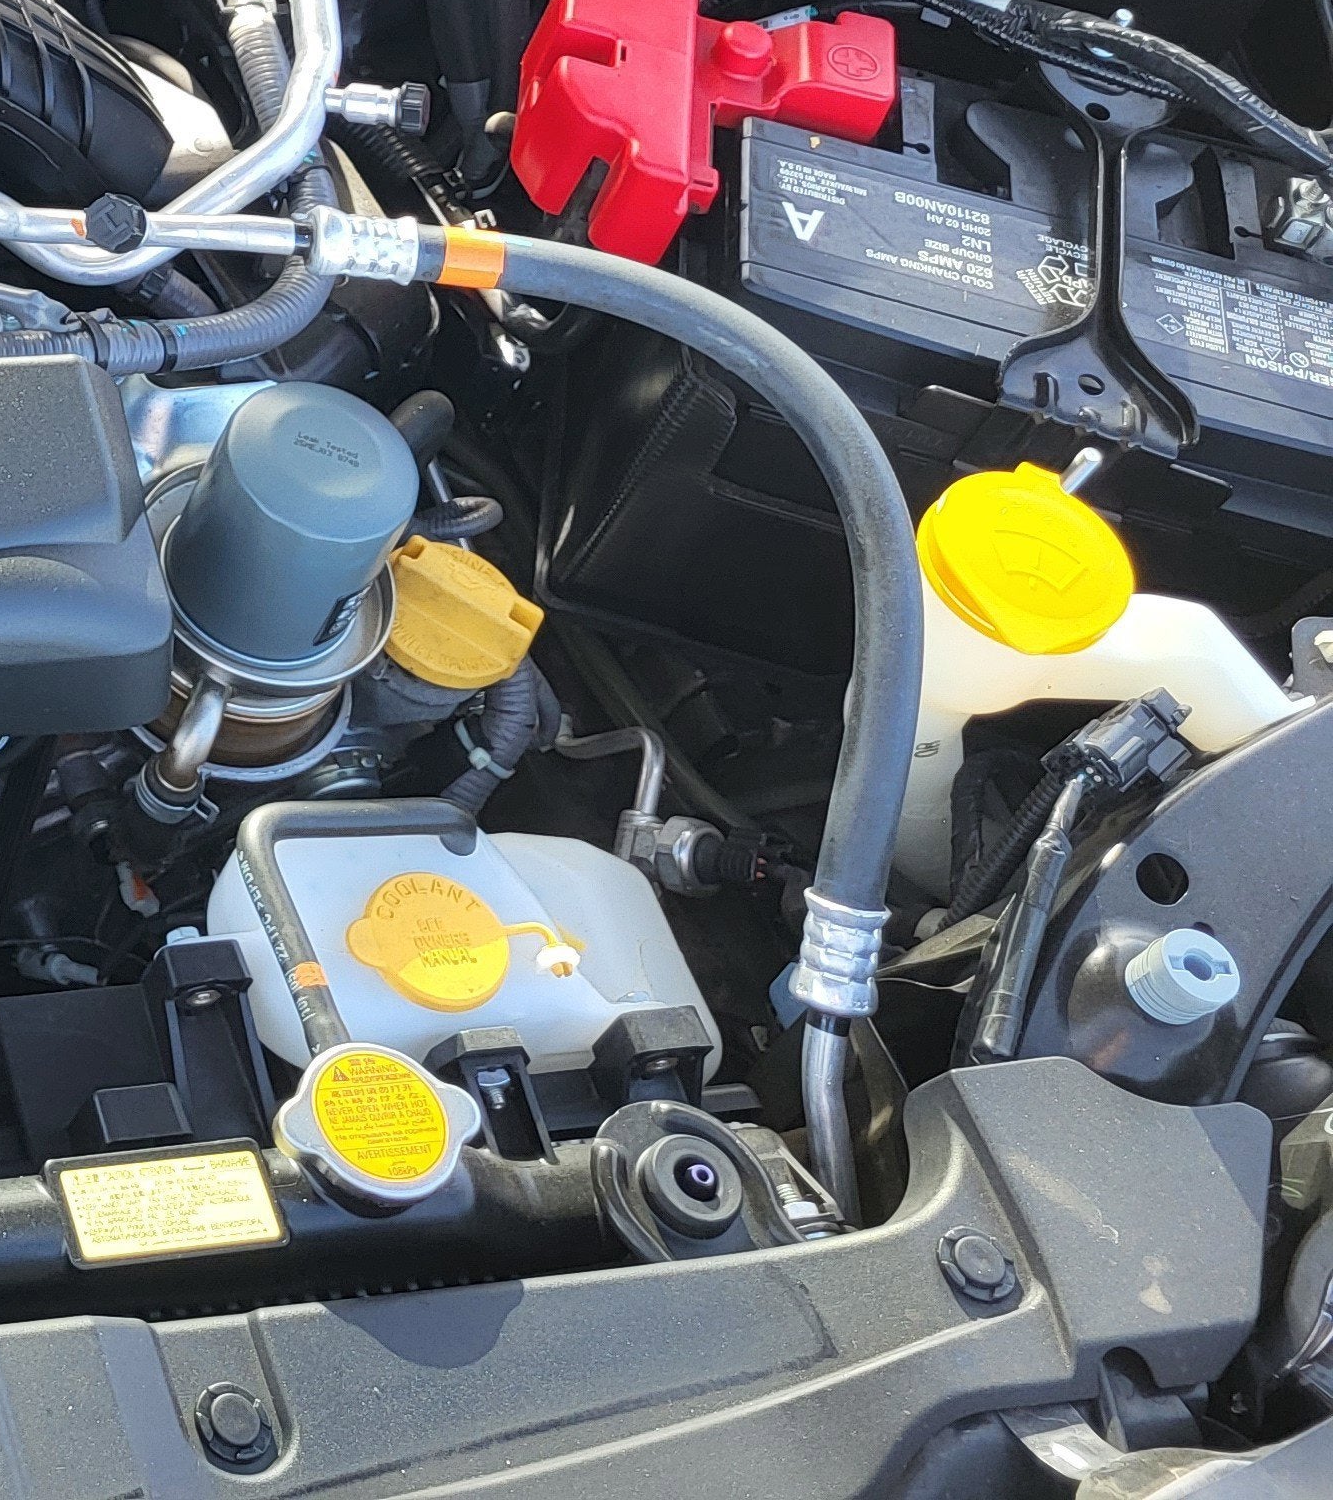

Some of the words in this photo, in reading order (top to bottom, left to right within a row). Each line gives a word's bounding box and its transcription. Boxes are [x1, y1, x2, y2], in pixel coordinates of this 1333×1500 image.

[793, 185, 845, 206] DISTRIBUTED
[891, 188, 990, 225] 82110AN00B
[780, 199, 825, 242] A
[924, 211, 943, 224] AH
[959, 219, 992, 237] 20HR
[922, 236, 949, 252] SIZE
[959, 232, 991, 251] LN2
[1043, 242, 1088, 261] ECYCLE
[863, 246, 898, 265] AMPS
[915, 247, 964, 271] AMPS
[949, 243, 992, 264] GROUP
[898, 255, 960, 281] CRANKING
[964, 260, 993, 280] 620
[960, 271, 994, 290] COLD
[1014, 267, 1048, 305] RETOUR
[1023, 266, 1057, 303] RETURN
[296, 430, 319, 443] Leak
[325, 440, 359, 459] Tested
[374, 875, 481, 919] COOLANT
[417, 945, 477, 968] MANUAL
[350, 1063, 398, 1076] WARNING
[325, 1105, 355, 1116] NEVER
[355, 1103, 380, 1113] OPEN
[379, 1100, 409, 1110] WHEN
[341, 1113, 367, 1123] JAMAIS
[368, 1110, 397, 1121] OUVRIR
[405, 1107, 431, 1117] CHAUD
[356, 1143, 432, 1160] AVERTISSEMENT
